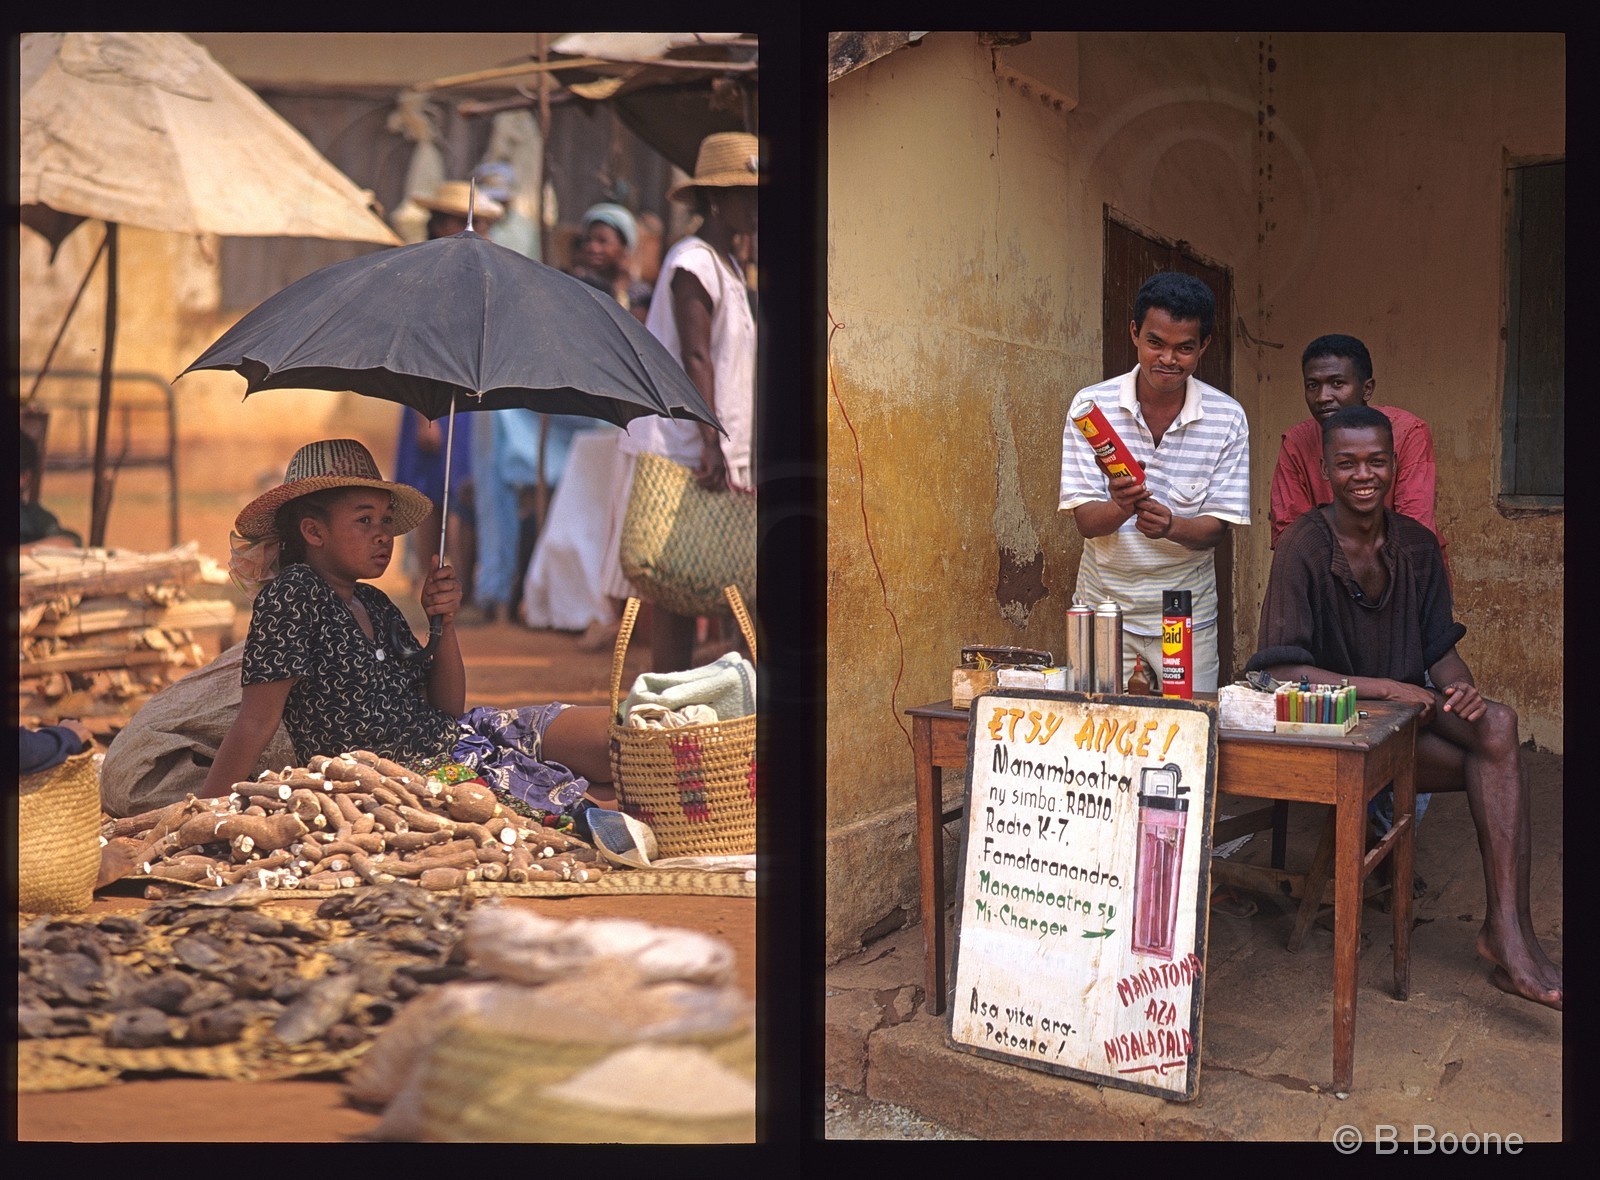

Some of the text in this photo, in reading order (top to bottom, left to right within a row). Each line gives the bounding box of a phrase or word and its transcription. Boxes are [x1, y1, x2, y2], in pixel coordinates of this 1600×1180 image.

[987, 707, 1064, 746] ETSY
[992, 743, 1133, 793] Manamboatra
[989, 786, 1007, 807] ny
[986, 806, 1032, 837] Radio
[979, 869, 1117, 924] Manamboatra sy
[1116, 952, 1203, 1008] MANATONA
[970, 986, 999, 1019] Asa
[1005, 1006, 1034, 1028] vita
[1144, 997, 1177, 1027] AZA
[1103, 1027, 1194, 1065] MISALASALA
